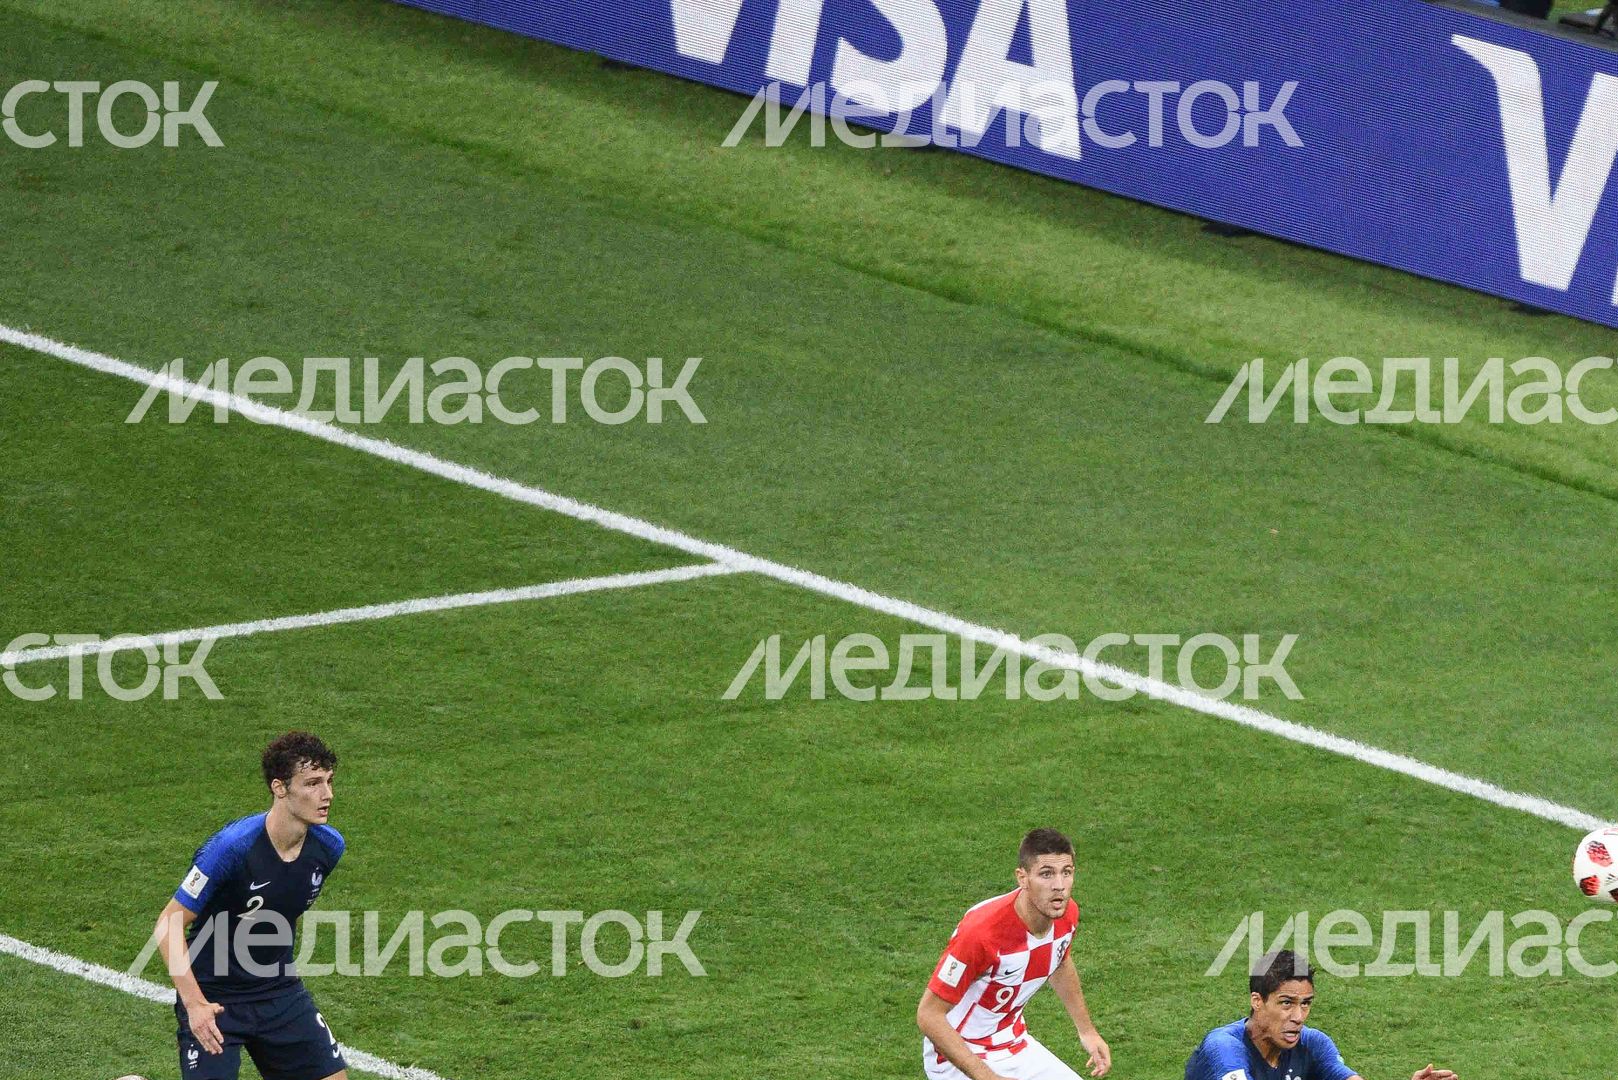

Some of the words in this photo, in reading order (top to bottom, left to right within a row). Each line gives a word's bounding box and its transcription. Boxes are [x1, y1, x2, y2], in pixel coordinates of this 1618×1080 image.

[667, 0, 1082, 160] SA
[237, 895, 264, 920] 2
[991, 986, 1014, 1013] 9
